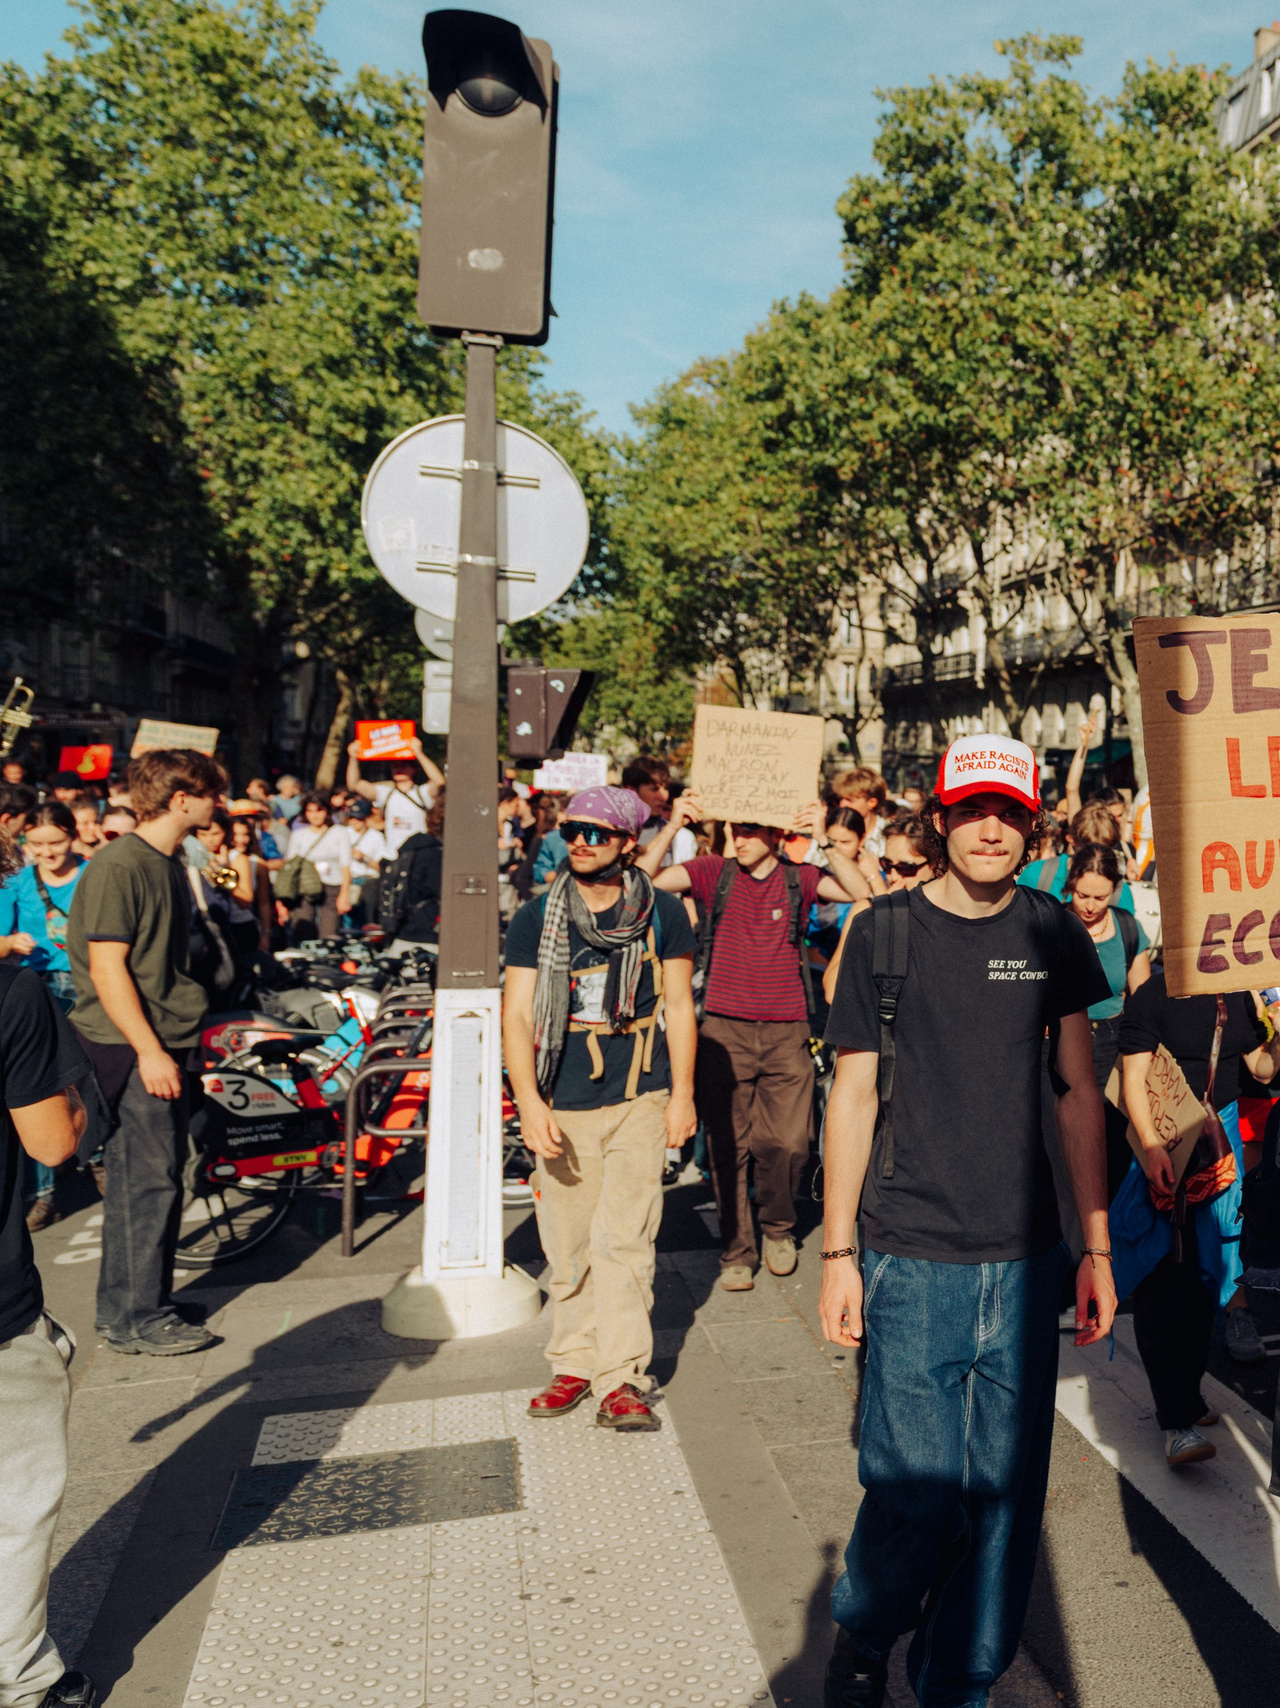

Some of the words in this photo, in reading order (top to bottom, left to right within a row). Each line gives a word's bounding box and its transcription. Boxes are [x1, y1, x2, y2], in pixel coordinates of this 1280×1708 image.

[706, 718, 798, 741] DARMANIN
[704, 753, 780, 773] MACRON
[954, 750, 987, 764] MAKE
[989, 750, 1030, 772] RACISTS
[955, 760, 997, 774] AFRAID
[998, 762, 1027, 781] AGAIN
[987, 959, 1006, 969] SEE
[1007, 959, 1028, 969] YOU
[987, 971, 1018, 980] SPACE
[1019, 970, 1050, 980] COWBO
[226, 1080, 250, 1111] 3
[251, 1092, 276, 1102] FREE
[226, 1125, 254, 1136] Move
[227, 1133, 259, 1147] spend
